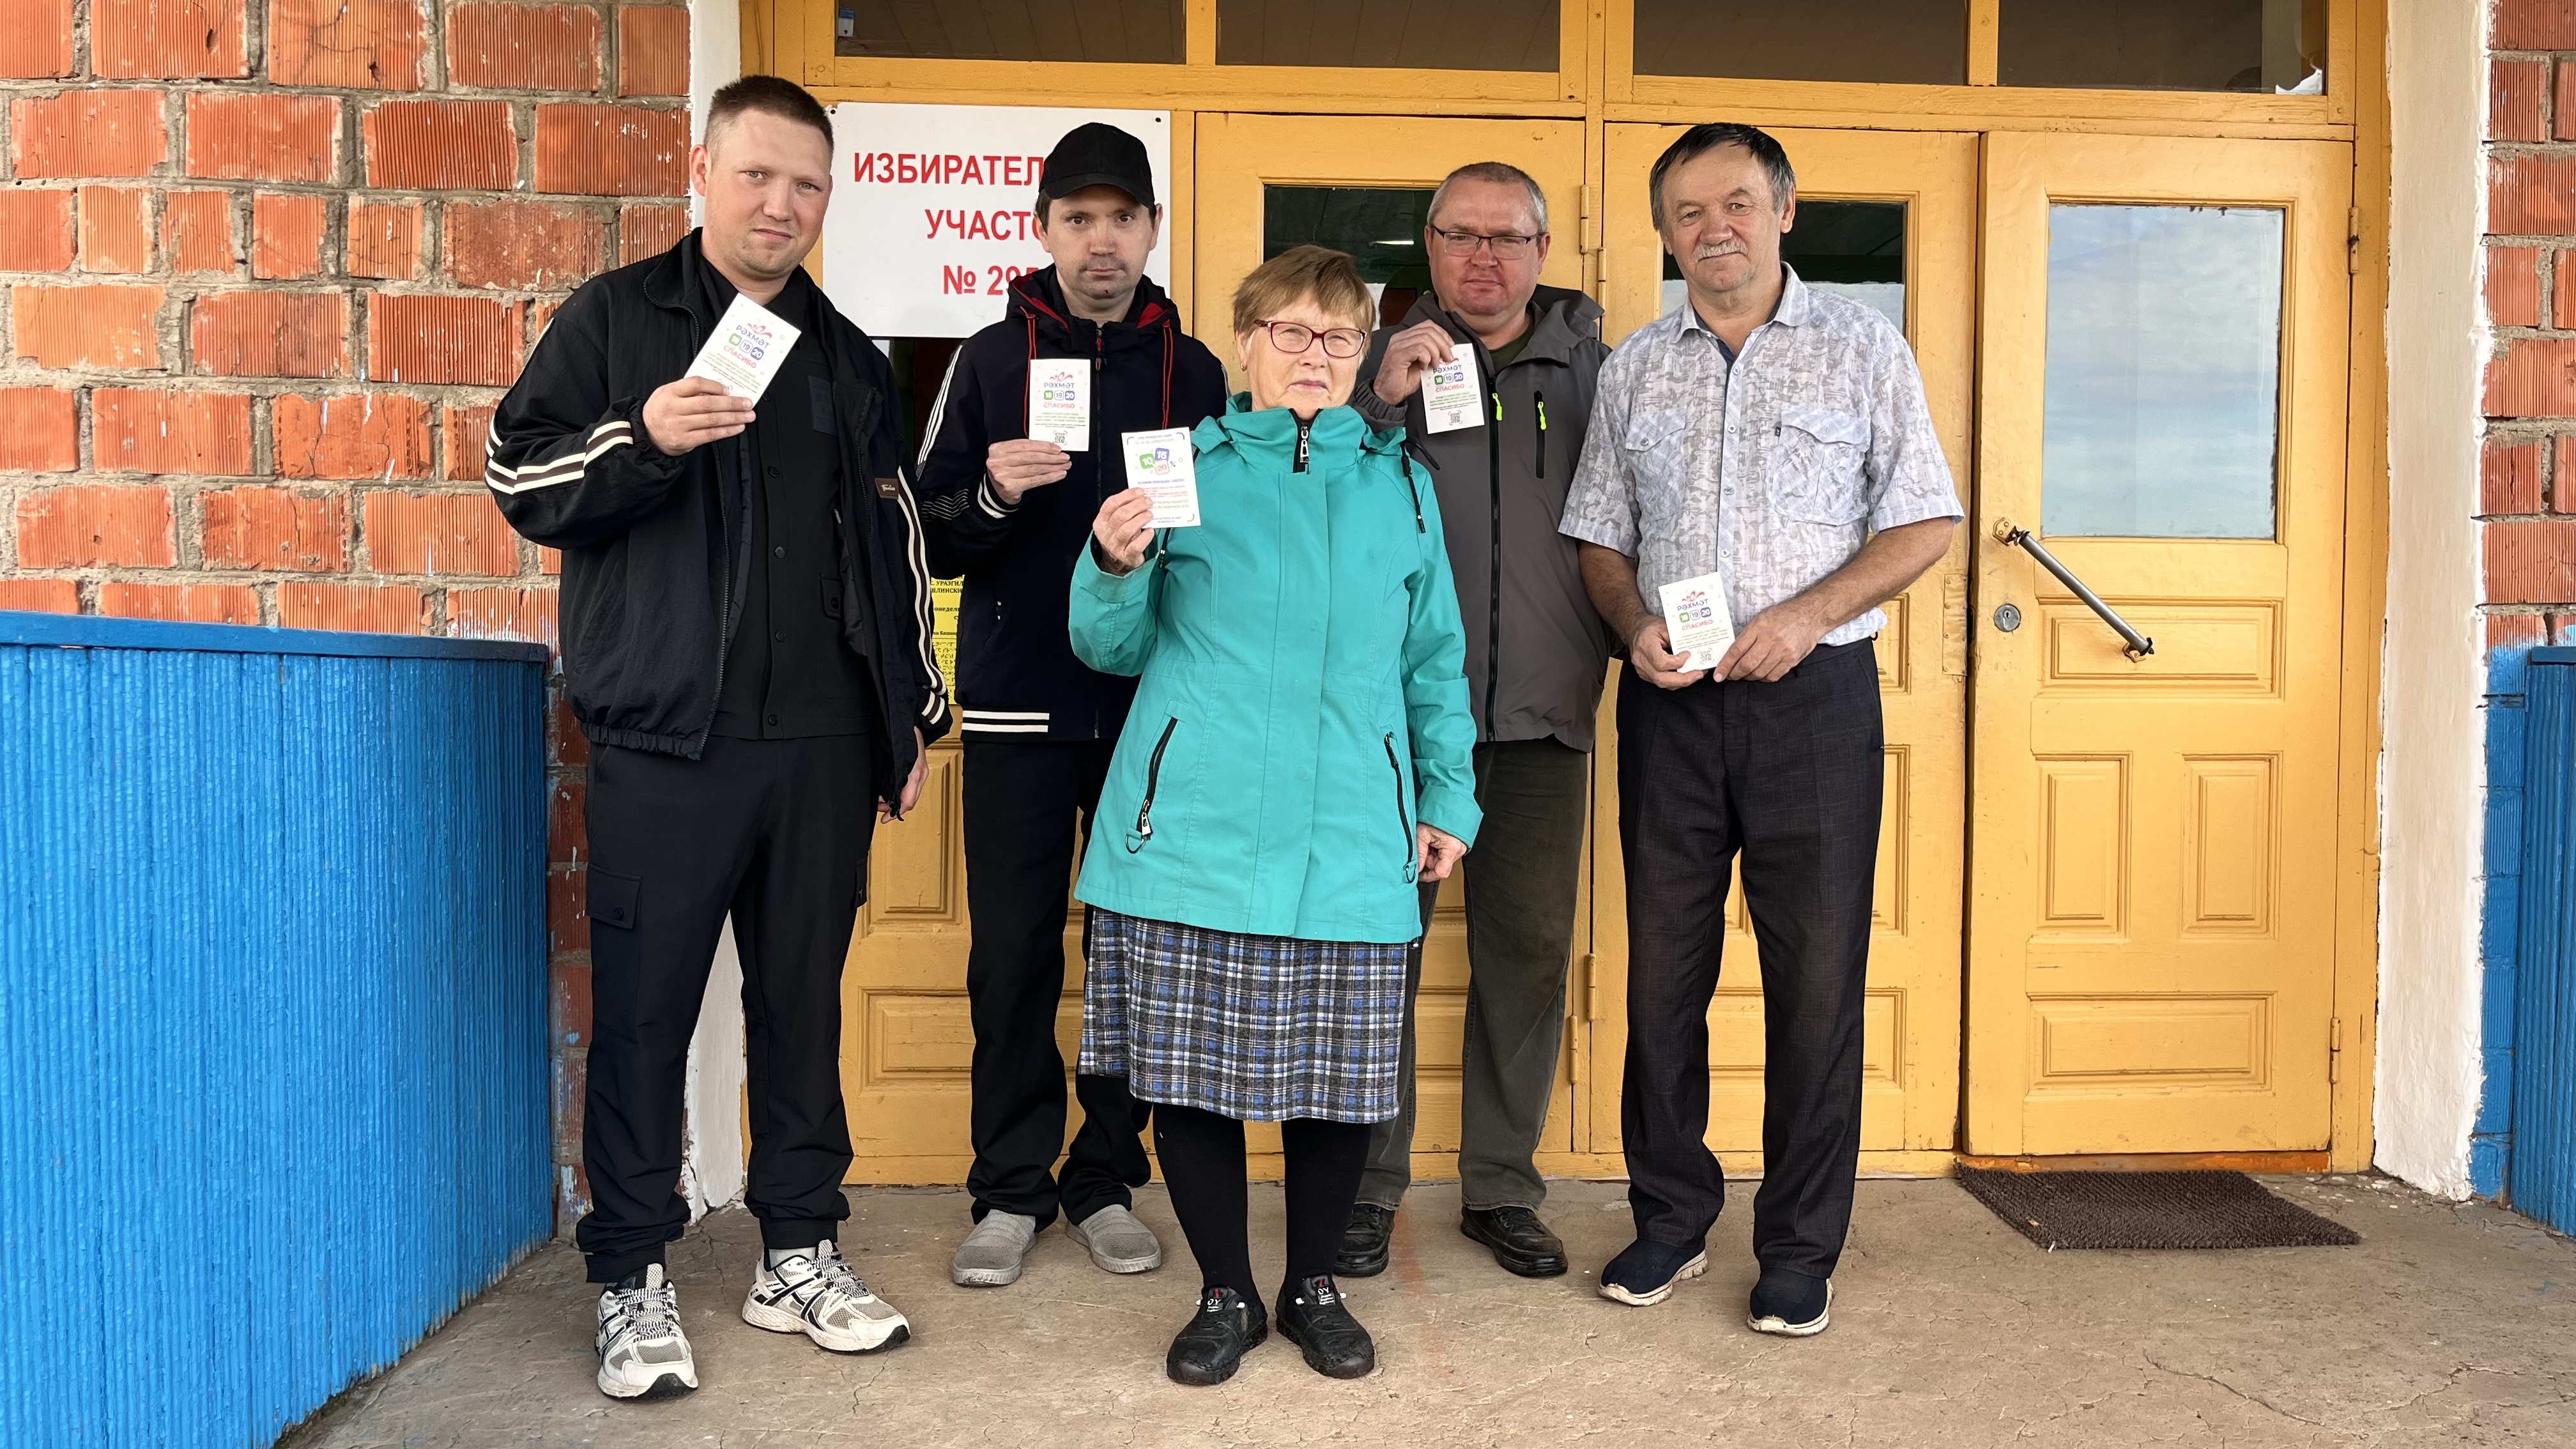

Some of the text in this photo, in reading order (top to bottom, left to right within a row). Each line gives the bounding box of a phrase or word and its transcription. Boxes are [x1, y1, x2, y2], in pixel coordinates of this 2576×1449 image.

[854, 152, 1045, 186] ИЗБИРАТЕЛ
[944, 265, 976, 295] №
[736, 325, 770, 348] РӘХМӘТ
[723, 345, 757, 369] СПАСИБО
[751, 348, 763, 359] 20
[1435, 383, 1465, 392] СПАСИБО
[1157, 451, 1168, 460] 15
[1142, 456, 1154, 467] 10
[1156, 464, 1167, 472] 20
[1701, 609, 1711, 617] 20
[1682, 619, 1713, 630] СПАСИБО
